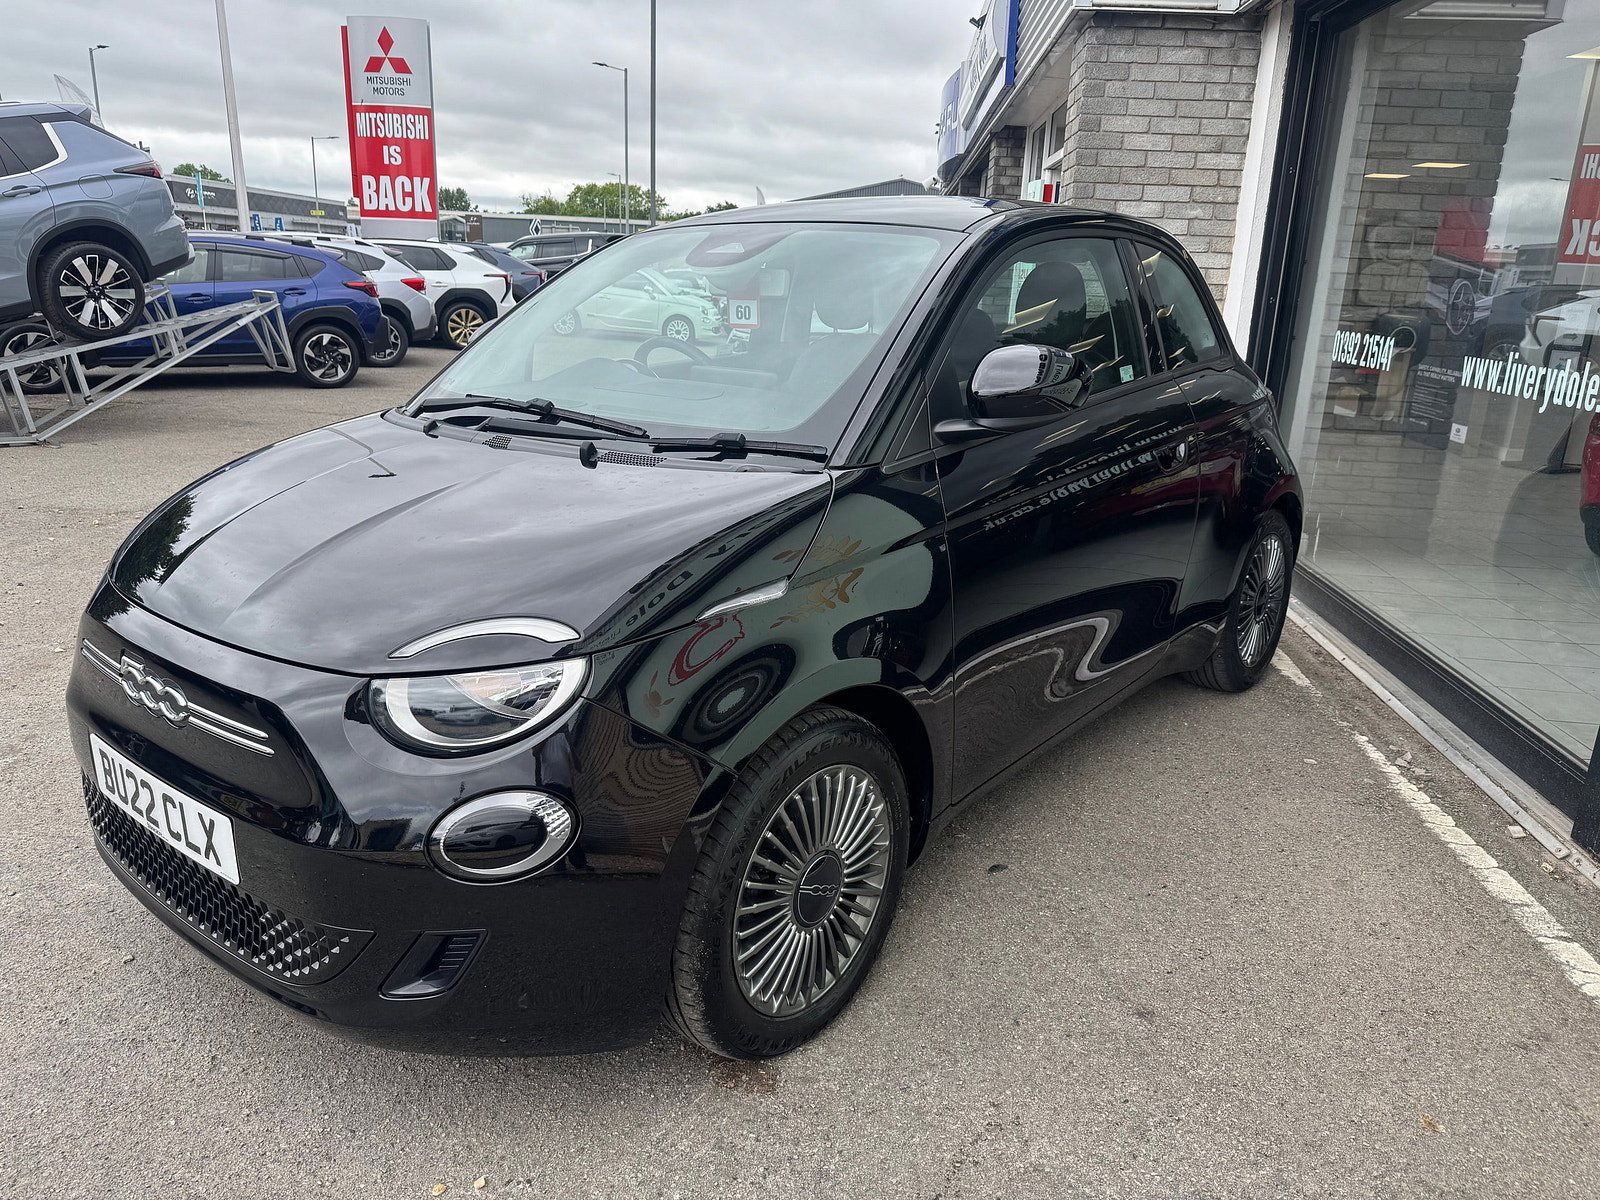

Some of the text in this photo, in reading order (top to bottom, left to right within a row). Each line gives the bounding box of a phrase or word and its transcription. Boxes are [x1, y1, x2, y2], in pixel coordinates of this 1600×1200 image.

[366, 76, 411, 87] MITSUBISHI
[372, 86, 405, 96] MOTORS
[356, 112, 429, 140] MITSUBISHI
[383, 145, 402, 165] IS
[361, 174, 432, 213] BACK
[735, 304, 751, 320] 60
[1332, 330, 1395, 372] 01392 215141
[99, 747, 222, 868] BU22 CLX
